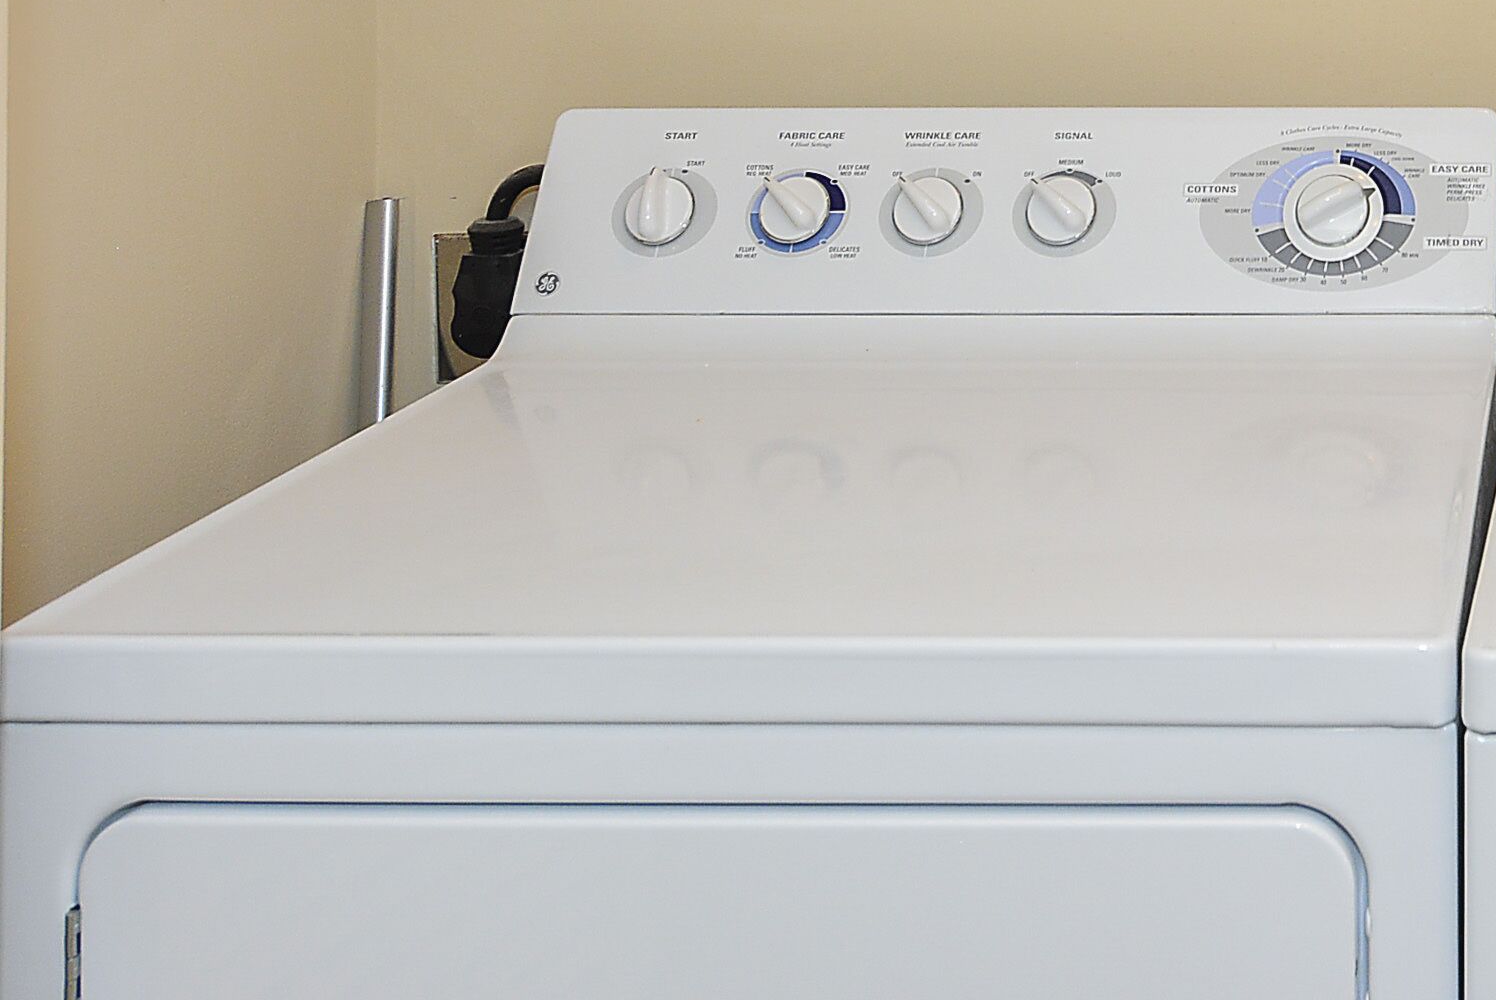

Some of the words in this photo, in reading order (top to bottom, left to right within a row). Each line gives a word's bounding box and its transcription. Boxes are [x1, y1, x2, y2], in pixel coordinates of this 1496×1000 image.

[665, 132, 698, 140] START
[778, 132, 816, 140] FABRIC
[818, 132, 845, 140] CARE
[904, 132, 952, 140] WRINKLE
[954, 132, 981, 140] CARE
[1055, 132, 1093, 140] SIGNAL
[1432, 165, 1458, 173] EASY
[1460, 165, 1489, 173] CARE
[1187, 185, 1237, 193] COTTONS
